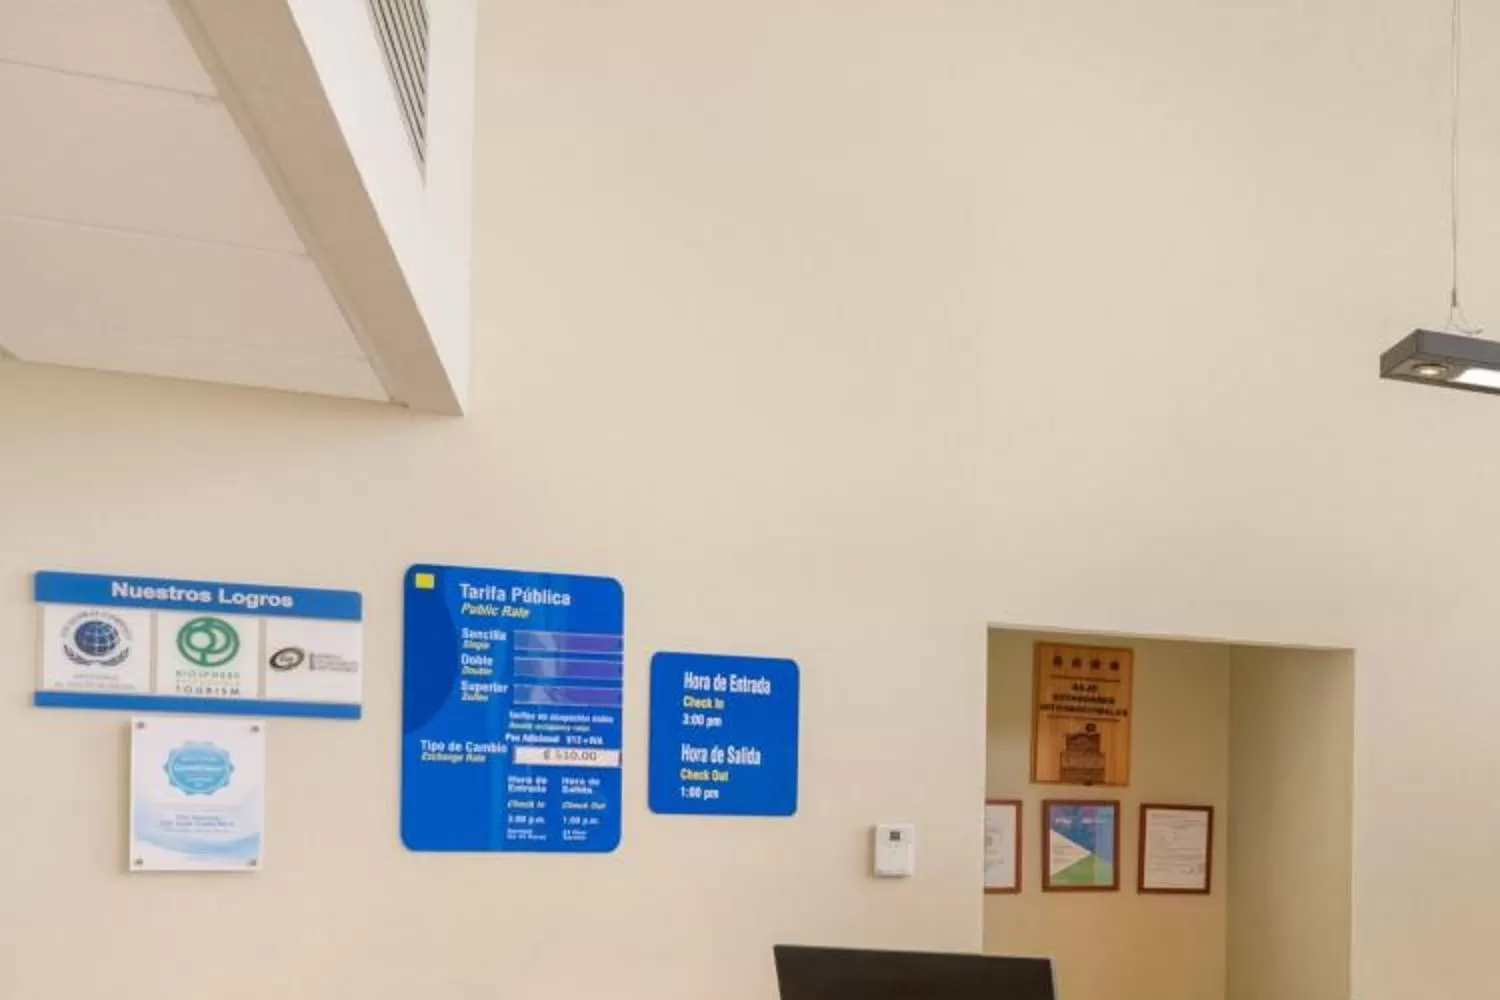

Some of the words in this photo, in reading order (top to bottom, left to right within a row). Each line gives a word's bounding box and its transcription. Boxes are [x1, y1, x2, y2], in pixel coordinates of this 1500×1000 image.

[111, 581, 212, 603] Nuestros
[218, 587, 294, 608] Logros
[458, 583, 506, 601] Tarifa
[511, 586, 571, 606] Pública
[461, 602, 499, 616] Public
[502, 604, 530, 618] Rate
[461, 627, 507, 641] Sencilla
[461, 653, 494, 666] Doble
[683, 672, 711, 691] Hora
[713, 674, 727, 692] de
[730, 674, 771, 695] Entrada
[683, 696, 712, 709] Check
[714, 697, 725, 710] In
[682, 713, 704, 726] 3:00
[706, 715, 722, 728] pm
[420, 739, 446, 753] Tipo
[447, 740, 463, 752] de
[465, 741, 508, 753] Cambio
[681, 744, 708, 763] Hora
[710, 746, 724, 764] de
[727, 746, 761, 766] Salida
[680, 768, 709, 781] Check
[711, 769, 729, 782] Out
[680, 786, 702, 798] 1:00
[703, 788, 719, 801] pm
